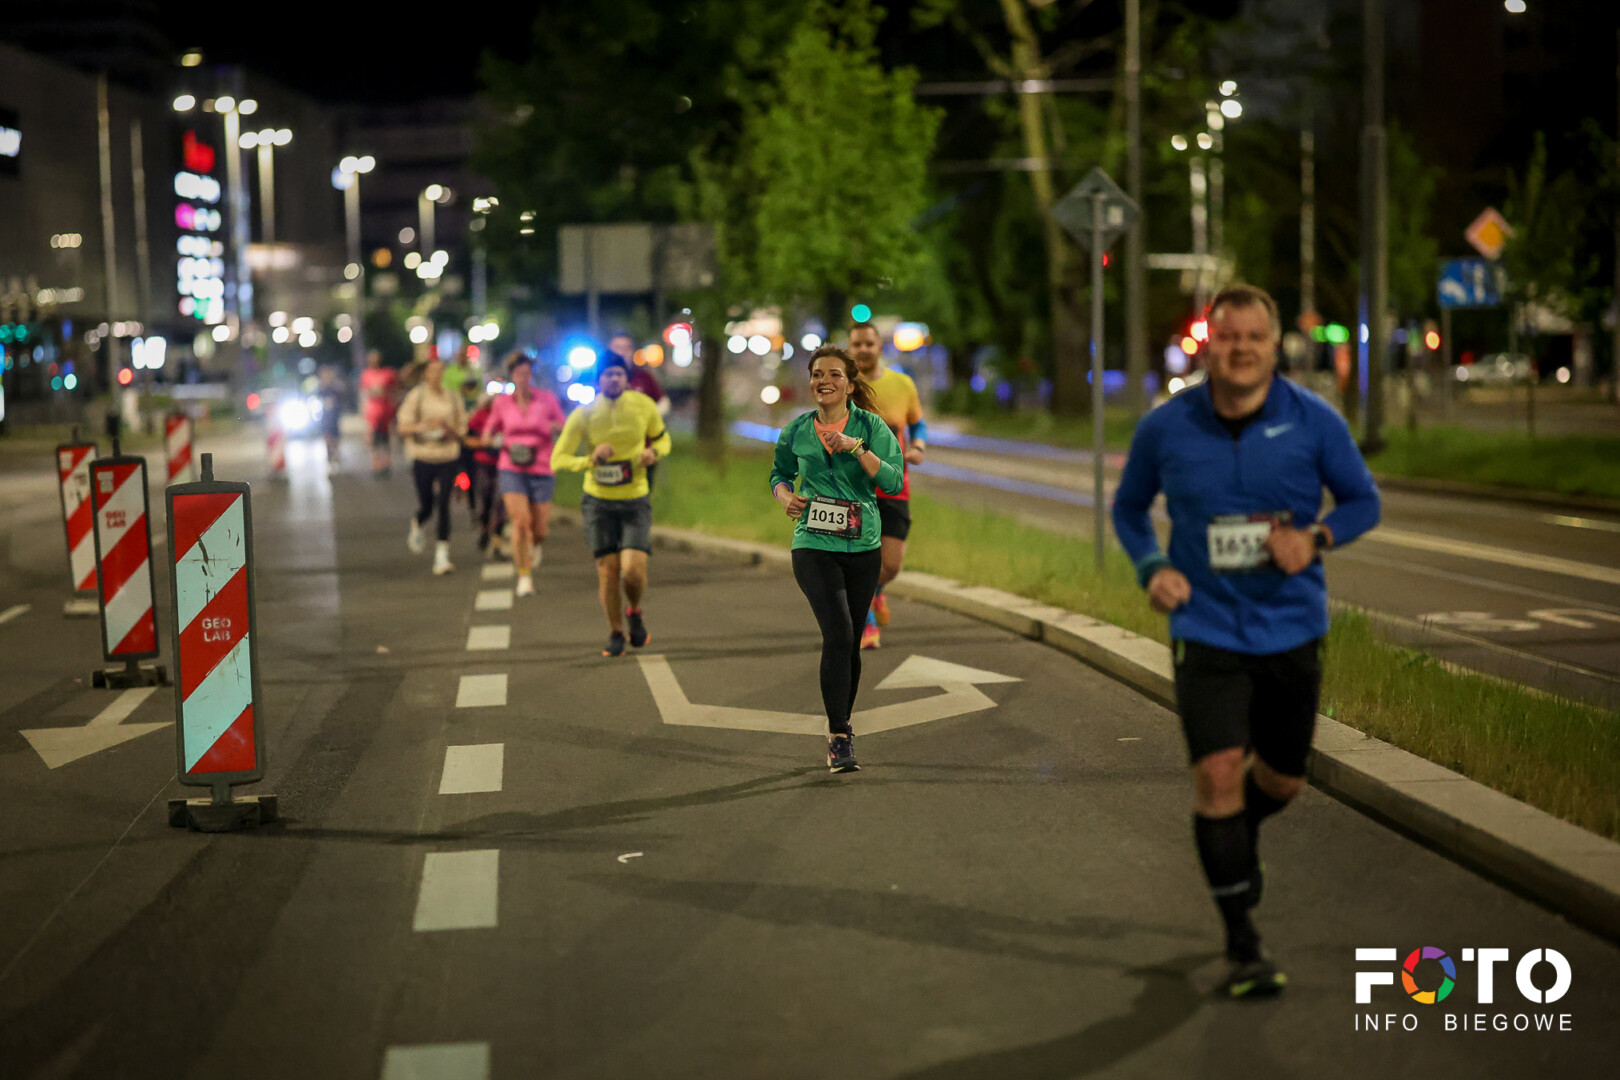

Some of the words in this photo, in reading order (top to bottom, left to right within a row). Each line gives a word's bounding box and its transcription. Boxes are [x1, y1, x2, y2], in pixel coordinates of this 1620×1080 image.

[812, 508, 845, 524] 1013
[202, 617, 231, 629] GEO
[203, 630, 231, 643] LAB
